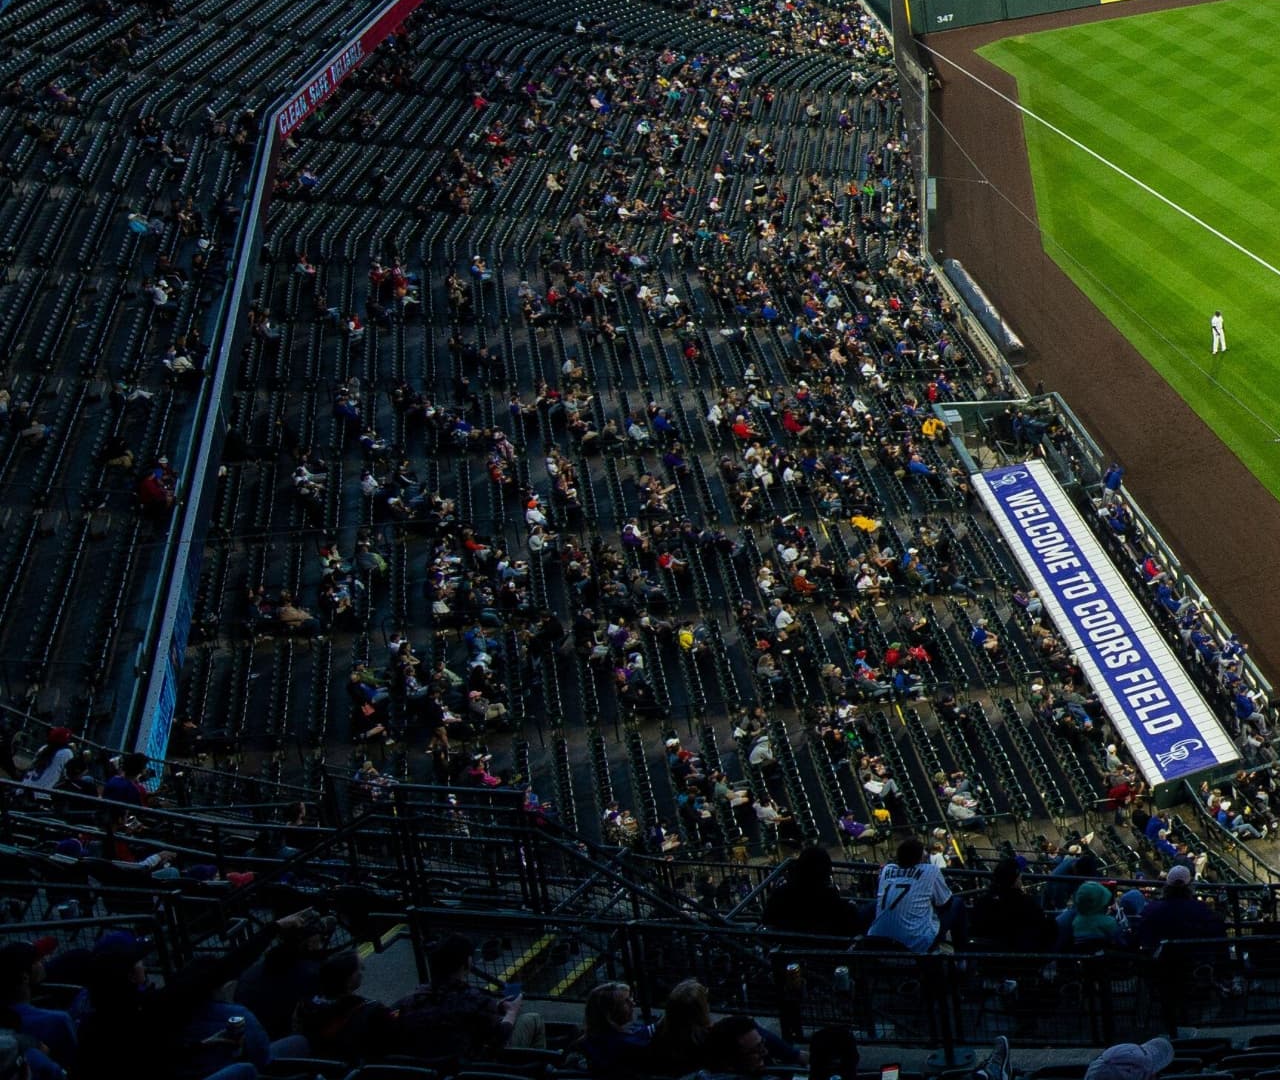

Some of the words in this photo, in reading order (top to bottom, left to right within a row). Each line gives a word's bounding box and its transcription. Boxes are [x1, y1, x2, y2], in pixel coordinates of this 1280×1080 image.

[936, 13, 953, 23] 347
[279, 99, 309, 134] CLEAN.
[1004, 489, 1081, 574] WELCOME
[1056, 571, 1098, 601] TO
[1072, 598, 1141, 670] COORS
[1114, 667, 1182, 735] FIELD
[881, 883, 912, 911] 17
